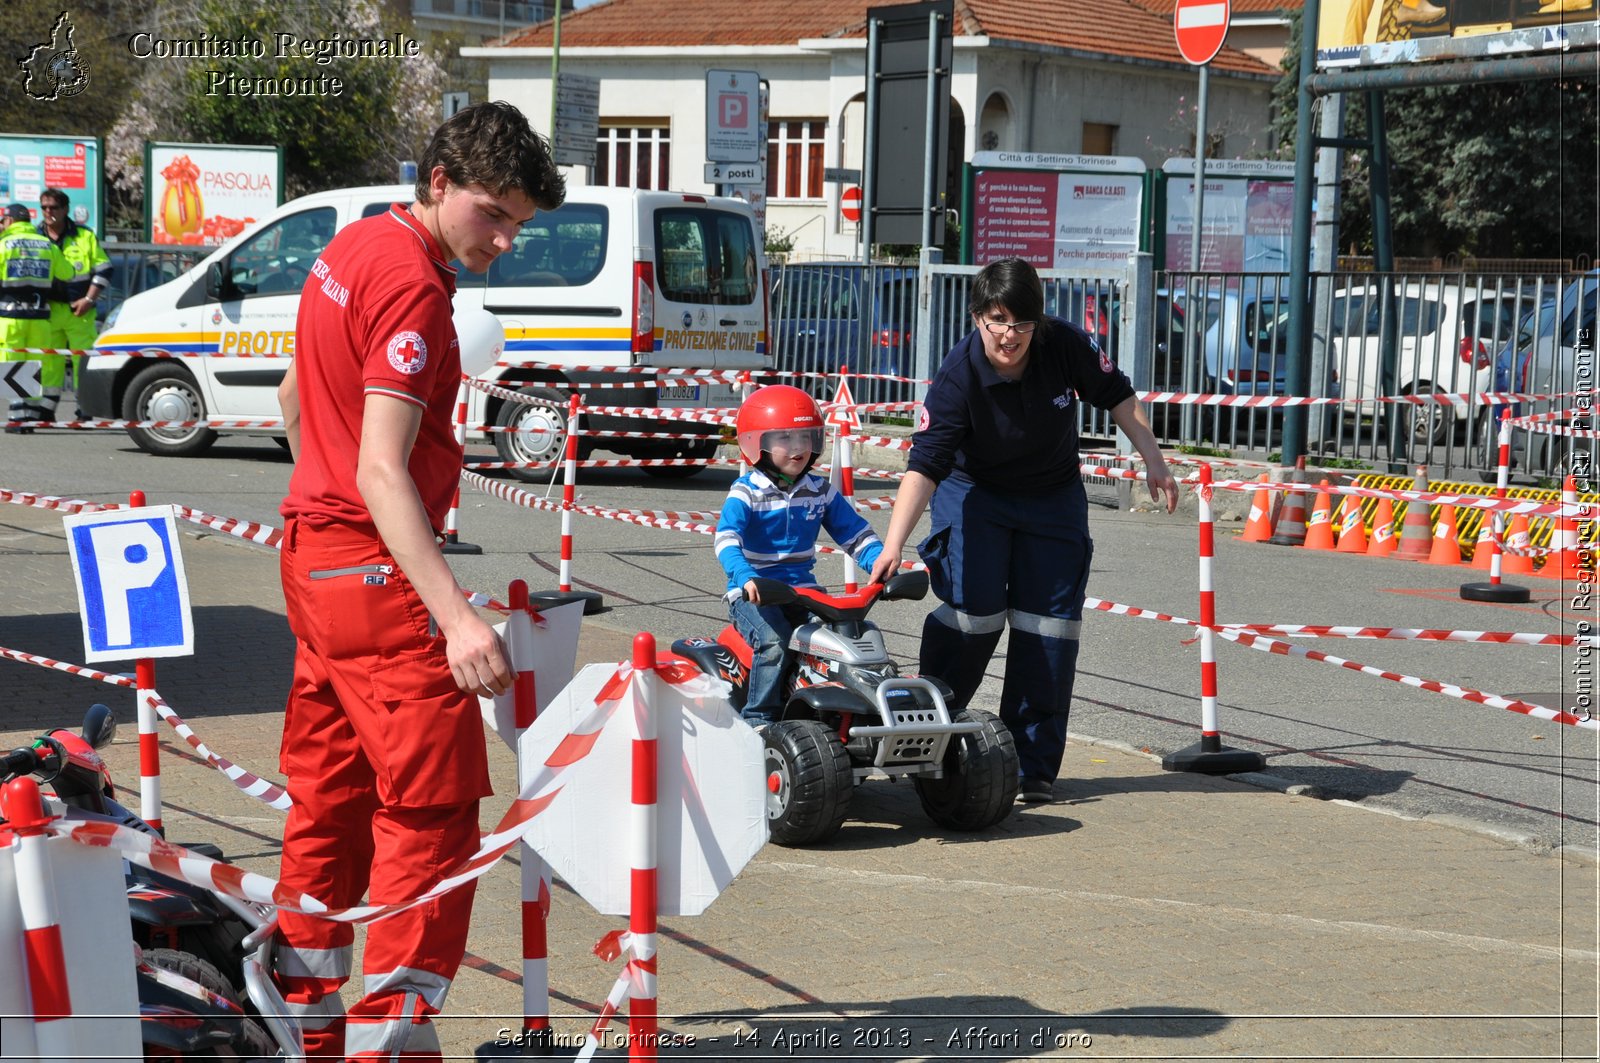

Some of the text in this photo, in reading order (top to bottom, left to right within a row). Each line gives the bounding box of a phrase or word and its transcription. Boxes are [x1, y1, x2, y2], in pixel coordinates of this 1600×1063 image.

[998, 152, 1117, 166] Città di Settimo Torinese
[1216, 161, 1225, 170] di
[1227, 161, 1264, 171] Settimo
[713, 168, 754, 180] 2 posti
[203, 170, 272, 191] PASQUA
[1085, 185, 1103, 195] BANCA
[1027, 197, 1042, 205] Socio
[1030, 219, 1050, 227] insieme
[1060, 224, 1134, 236] Aumento di capitale
[1012, 243, 1028, 252] piace
[664, 330, 757, 351] PROTEZIONE CIVILE
[90, 521, 167, 646] P
